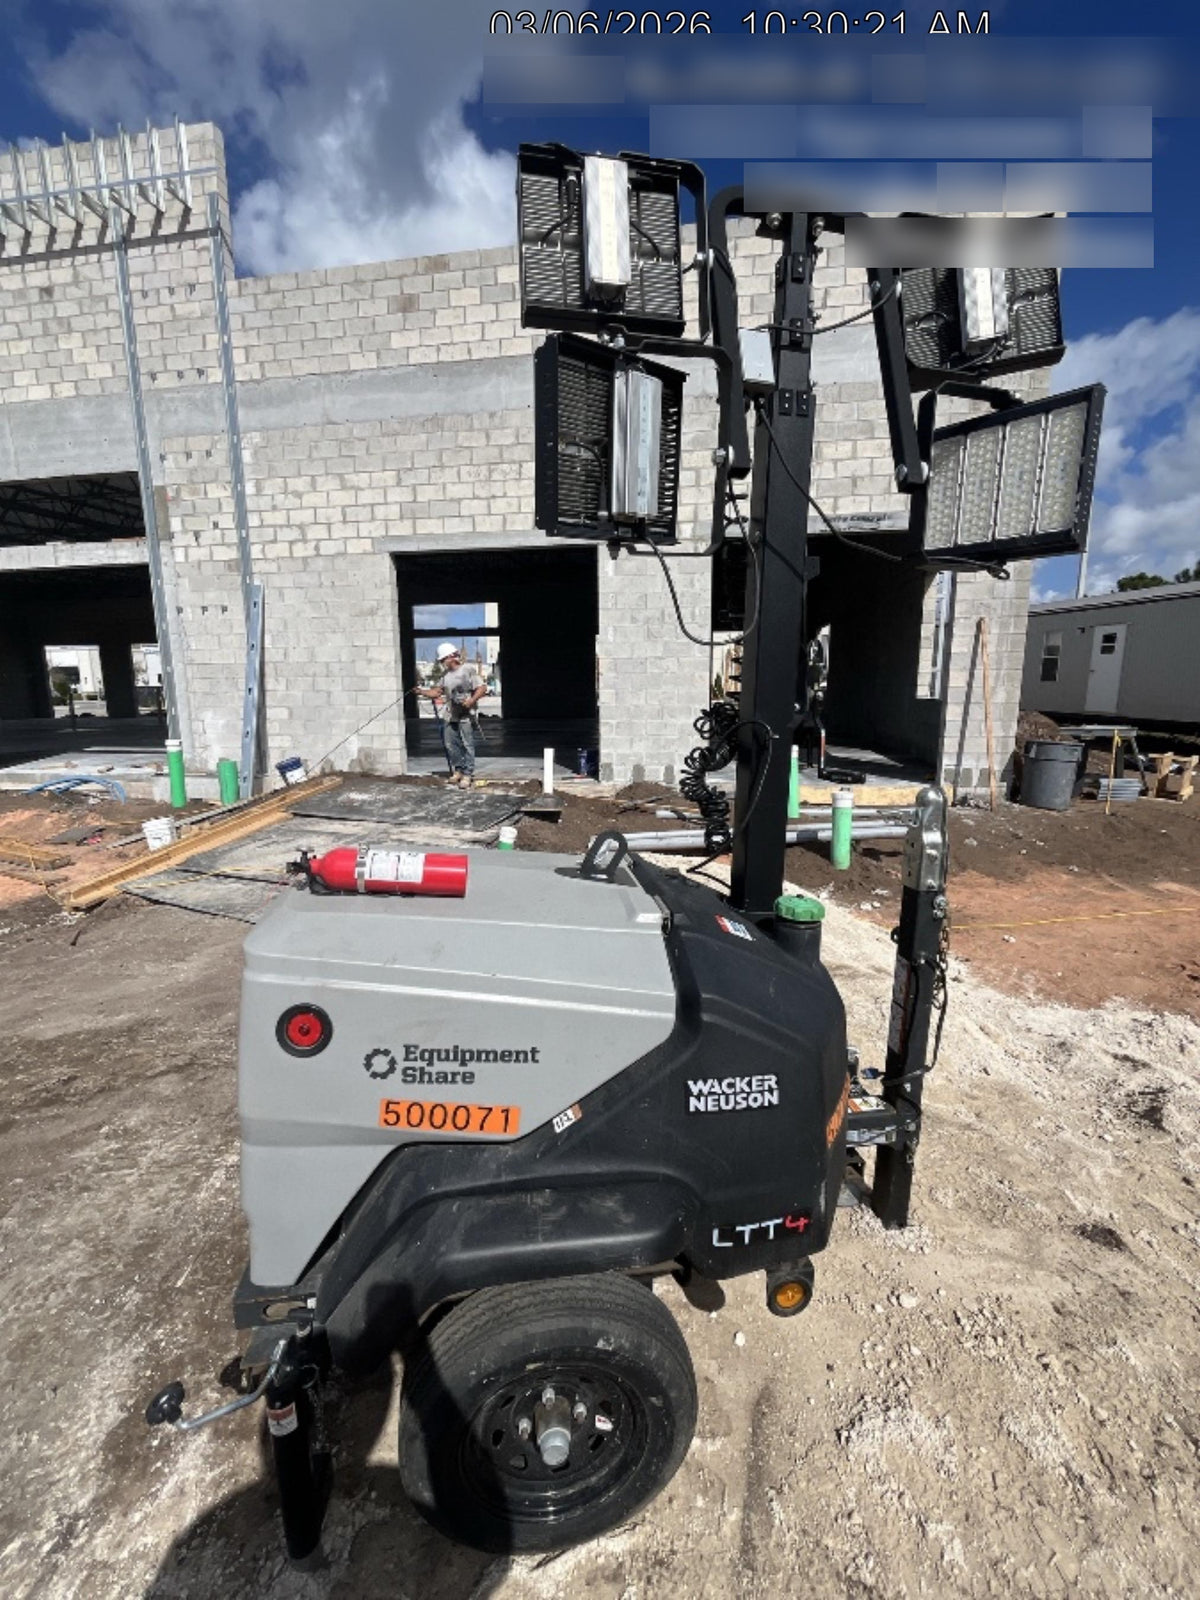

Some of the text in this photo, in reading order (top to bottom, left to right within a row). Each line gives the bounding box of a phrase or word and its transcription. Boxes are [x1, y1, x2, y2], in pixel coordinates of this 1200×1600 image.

[402, 1044, 541, 1067] Equipment
[401, 1066, 475, 1085] Share
[687, 1074, 779, 1096] WACKER
[689, 1090, 780, 1112] NEUSON
[383, 1101, 511, 1133] 500071
